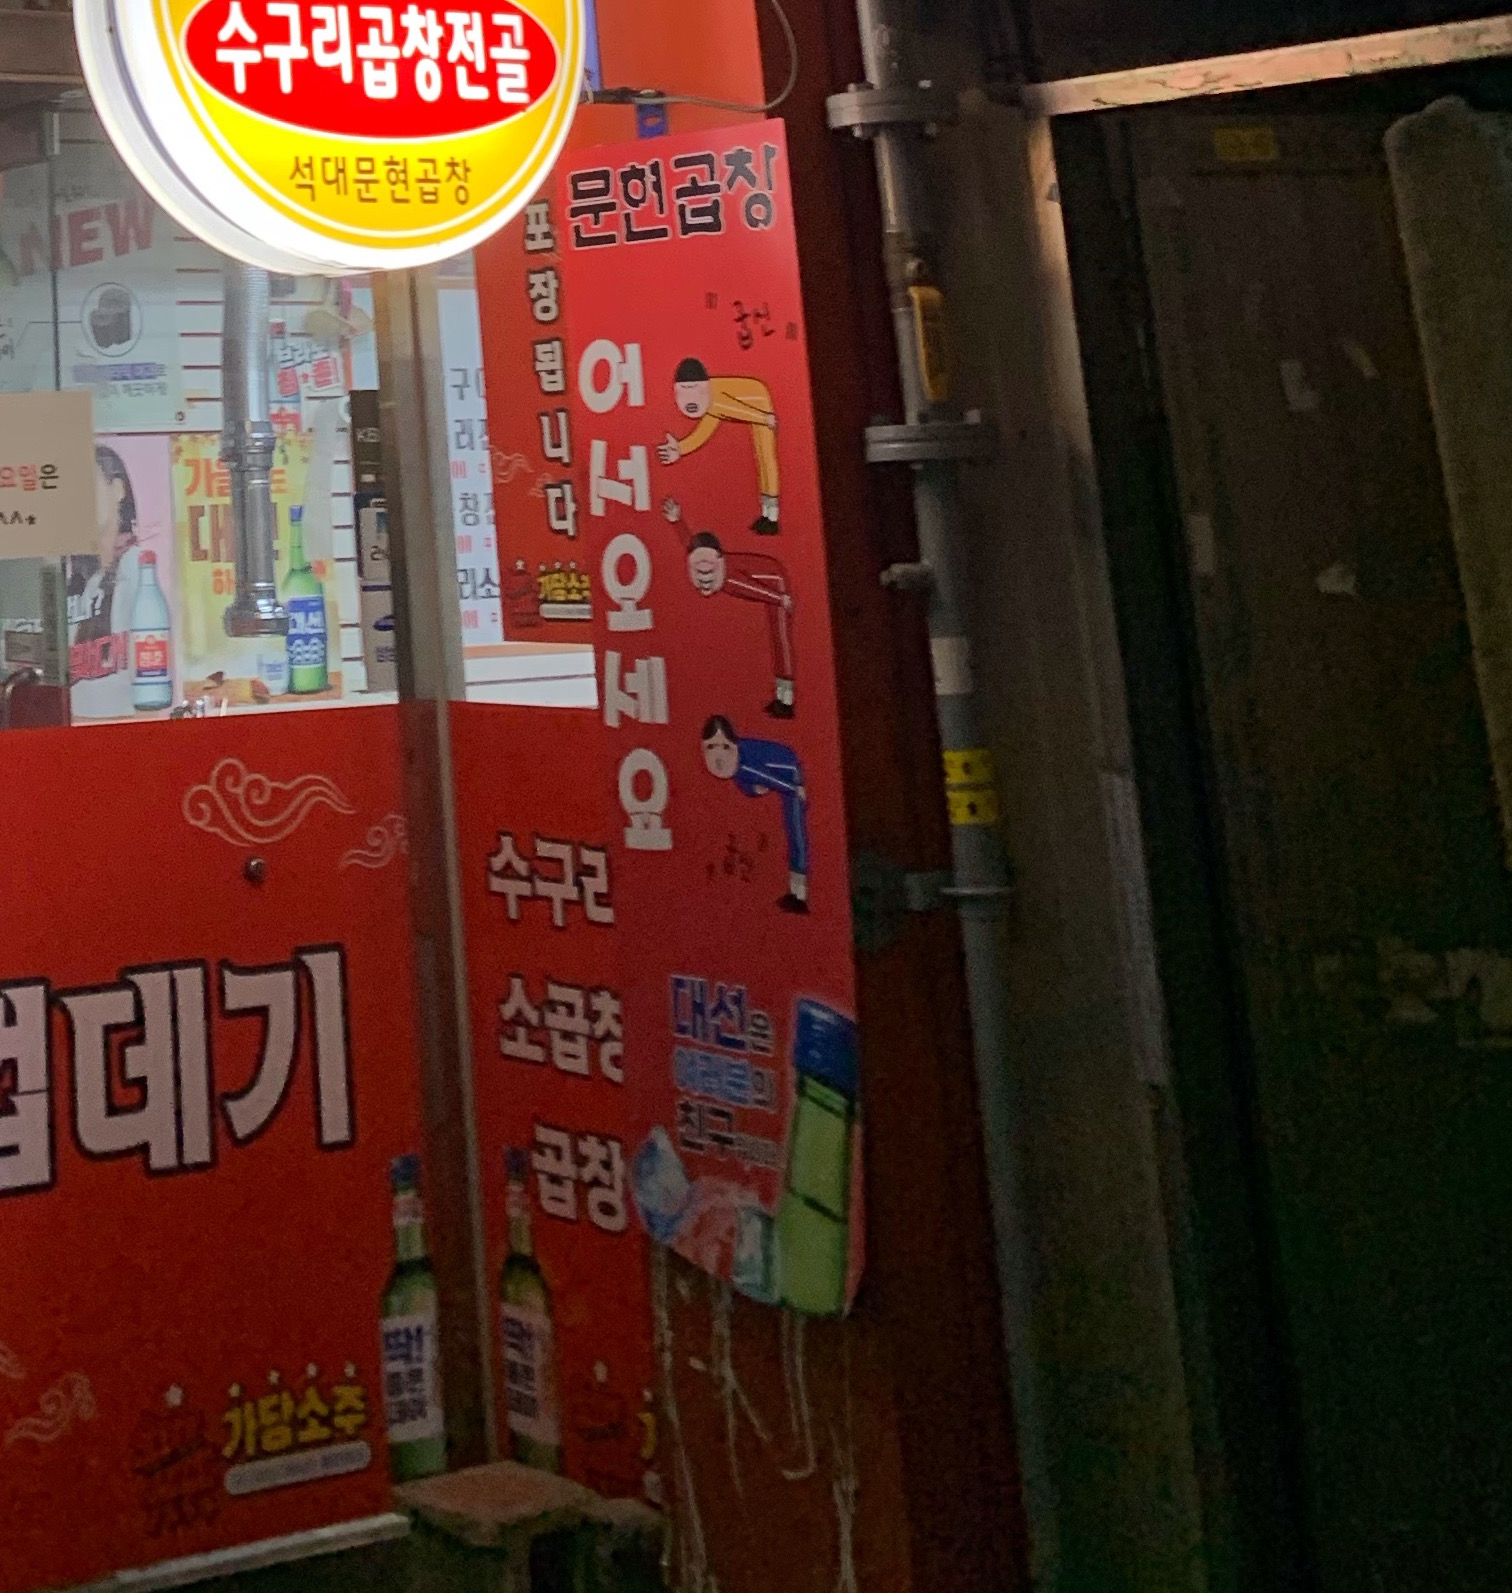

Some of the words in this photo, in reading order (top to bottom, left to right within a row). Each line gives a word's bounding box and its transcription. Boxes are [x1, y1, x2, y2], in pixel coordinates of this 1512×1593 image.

[215, 0, 533, 105] 수구리곱창전골
[288, 153, 474, 207] 석대문현곱창
[567, 144, 779, 250] 문현곱창
[523, 200, 578, 539] 포장됩니다
[578, 338, 673, 851] 어서오세요
[669, 974, 774, 1057] 대선은
